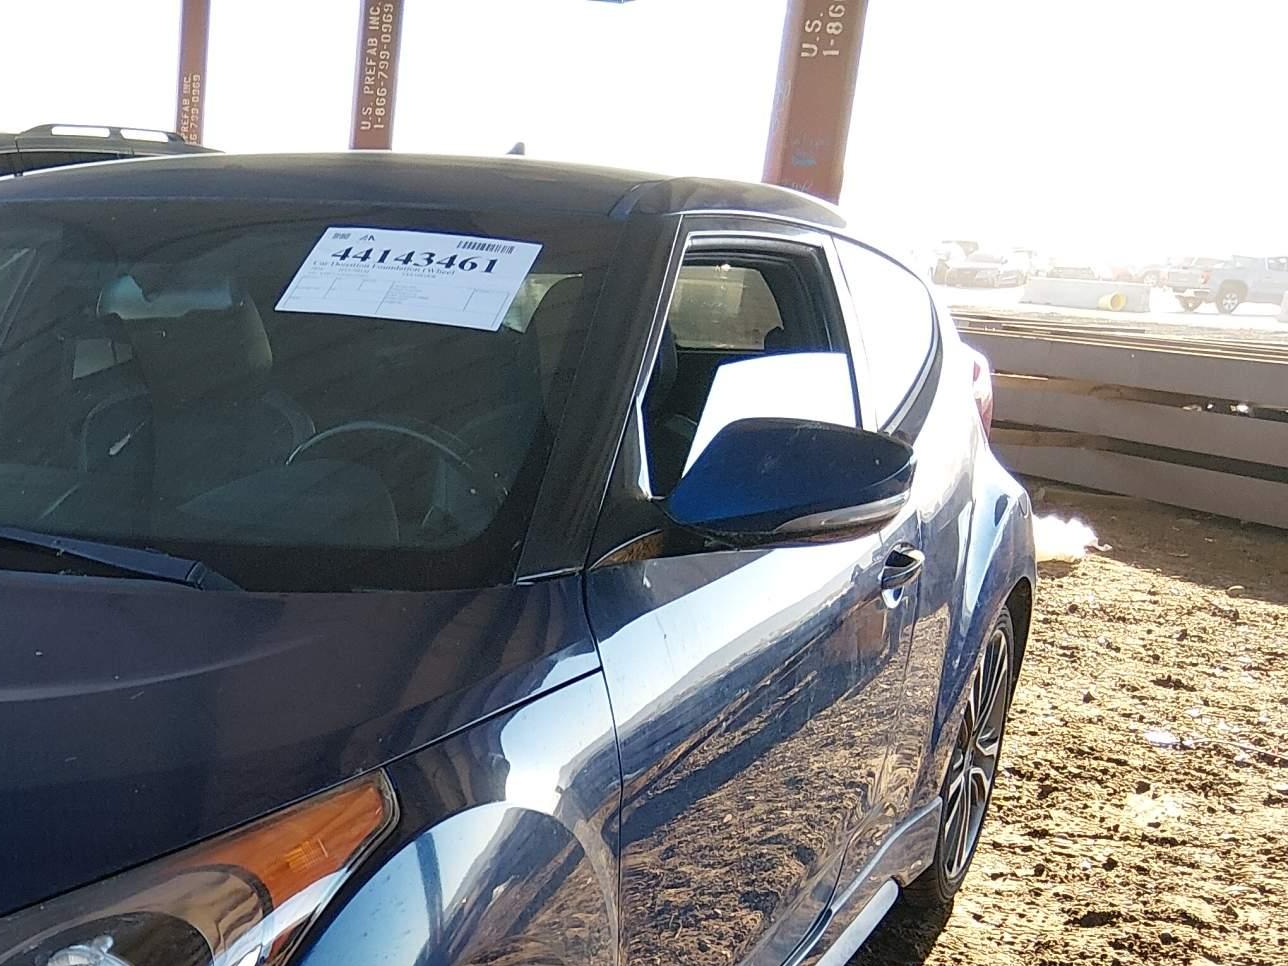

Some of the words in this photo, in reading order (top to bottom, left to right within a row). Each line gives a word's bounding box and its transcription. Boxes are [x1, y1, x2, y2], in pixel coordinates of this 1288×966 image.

[801, 12, 825, 57] U.S.
[822, 0, 846, 56] 1-86
[363, 37, 379, 95] PREFAB
[373, 3, 394, 129] 1-866-799-0969
[361, 102, 375, 131] U.S.
[331, 246, 499, 274] 44143461
